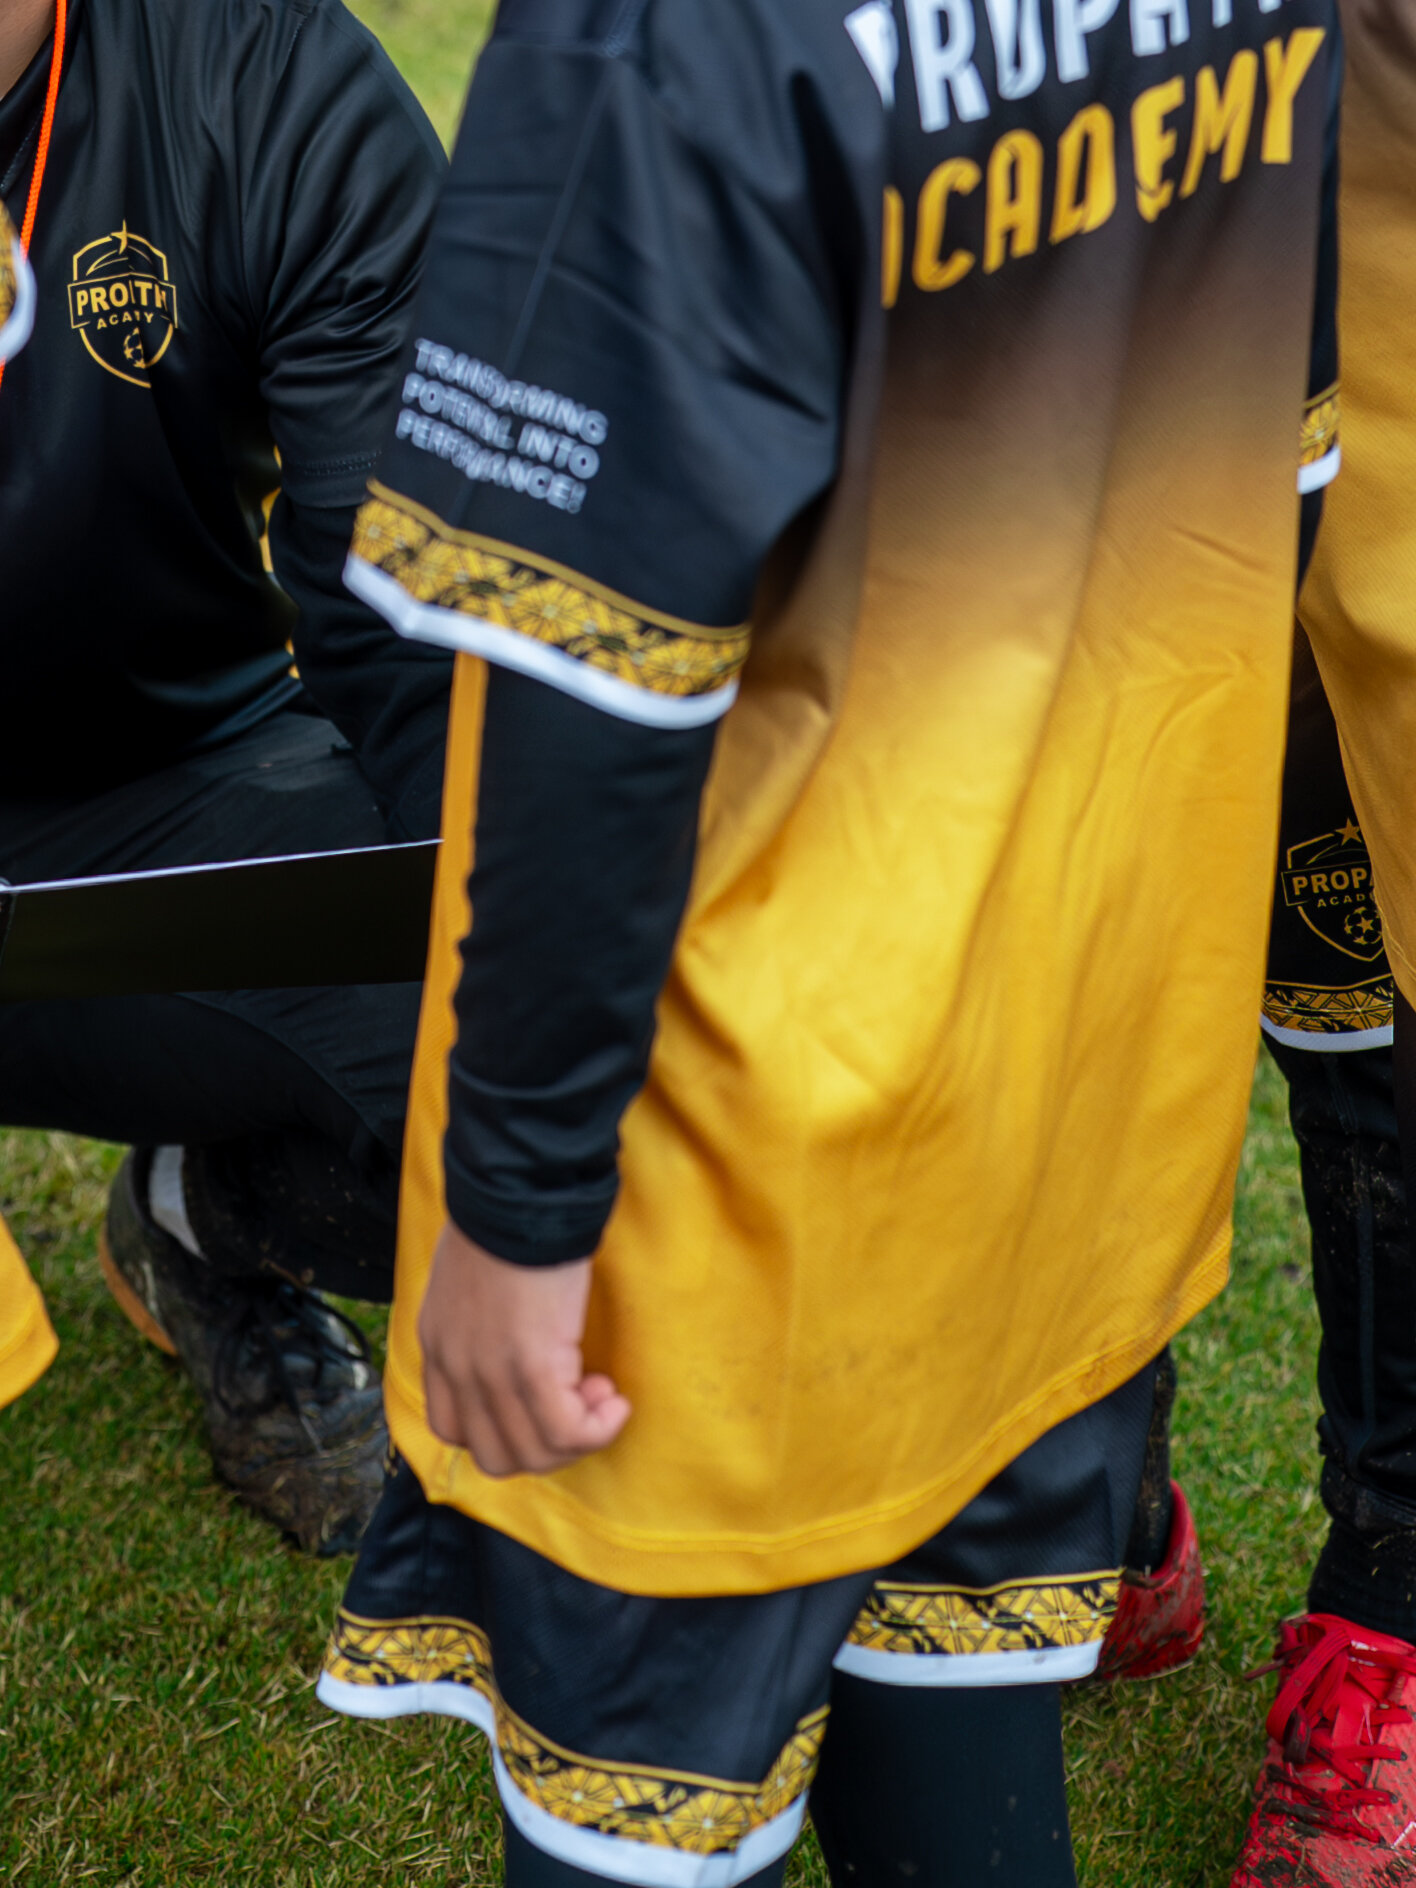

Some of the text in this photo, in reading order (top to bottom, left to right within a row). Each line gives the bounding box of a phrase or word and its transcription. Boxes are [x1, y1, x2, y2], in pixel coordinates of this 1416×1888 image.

[76, 280, 168, 317] PROTH
[96, 310, 154, 330] ACAY
[518, 422, 600, 479] INTO
[1292, 867, 1374, 896] PROP
[1317, 892, 1374, 908] ACAD
